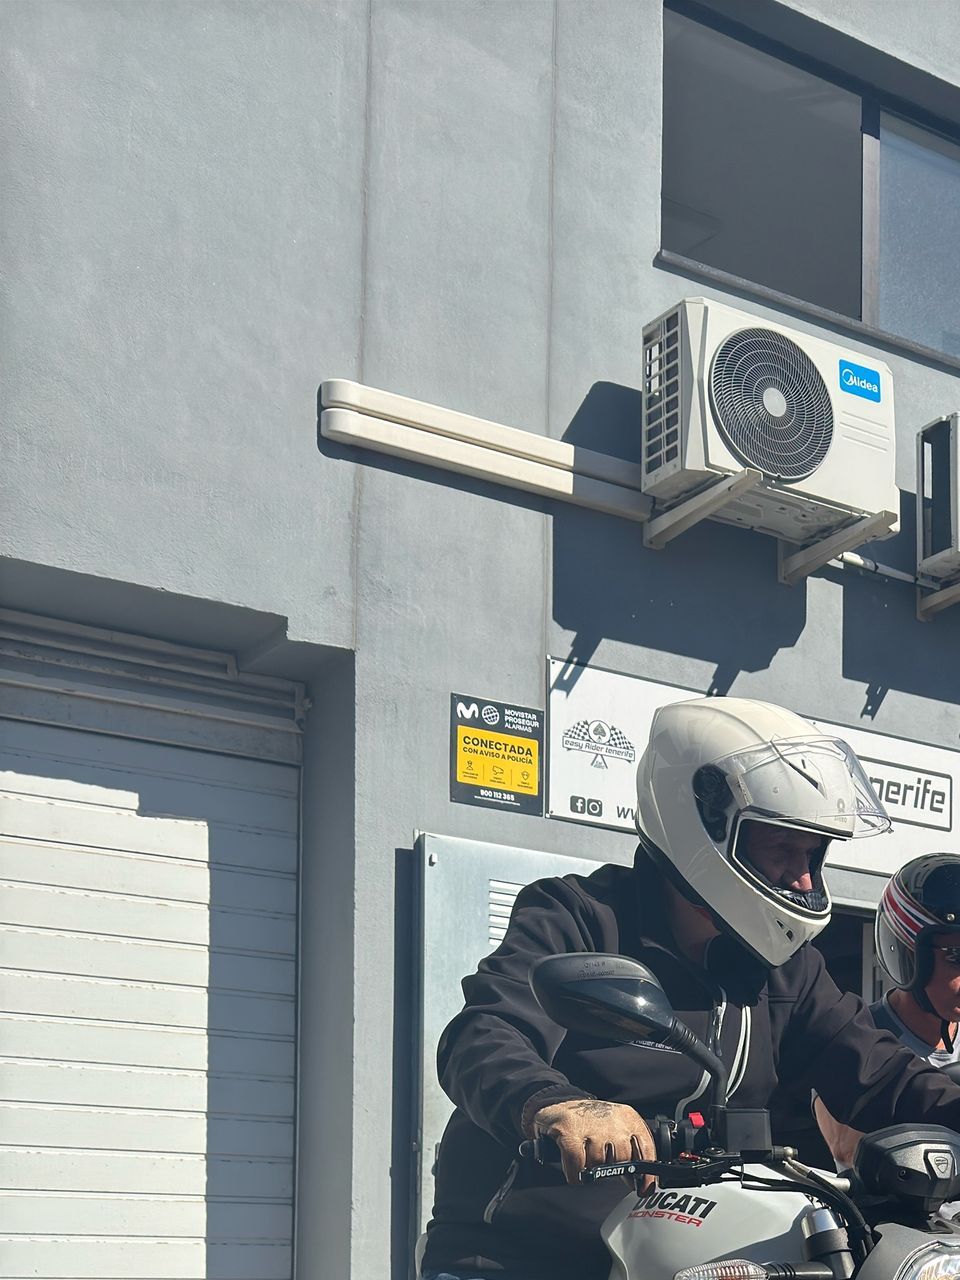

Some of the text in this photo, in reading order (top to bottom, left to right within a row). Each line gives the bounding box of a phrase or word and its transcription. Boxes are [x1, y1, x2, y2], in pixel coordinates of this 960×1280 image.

[842, 368, 879, 393] Midea
[504, 708, 537, 721] MOVISTAR
[504, 716, 540, 728] PROSEGUR
[504, 723, 533, 733] ALARMAS
[462, 735, 533, 757] CONECTADA
[564, 738, 634, 759] easy Rider tenerife
[462, 746, 479, 755] CON
[479, 748, 500, 759] AVISO
[507, 754, 534, 765] POLICÍA
[480, 789, 492, 798] 900
[493, 790, 502, 799] 112
[503, 792, 515, 801] 365
[595, 1167, 625, 1179] DUCATI
